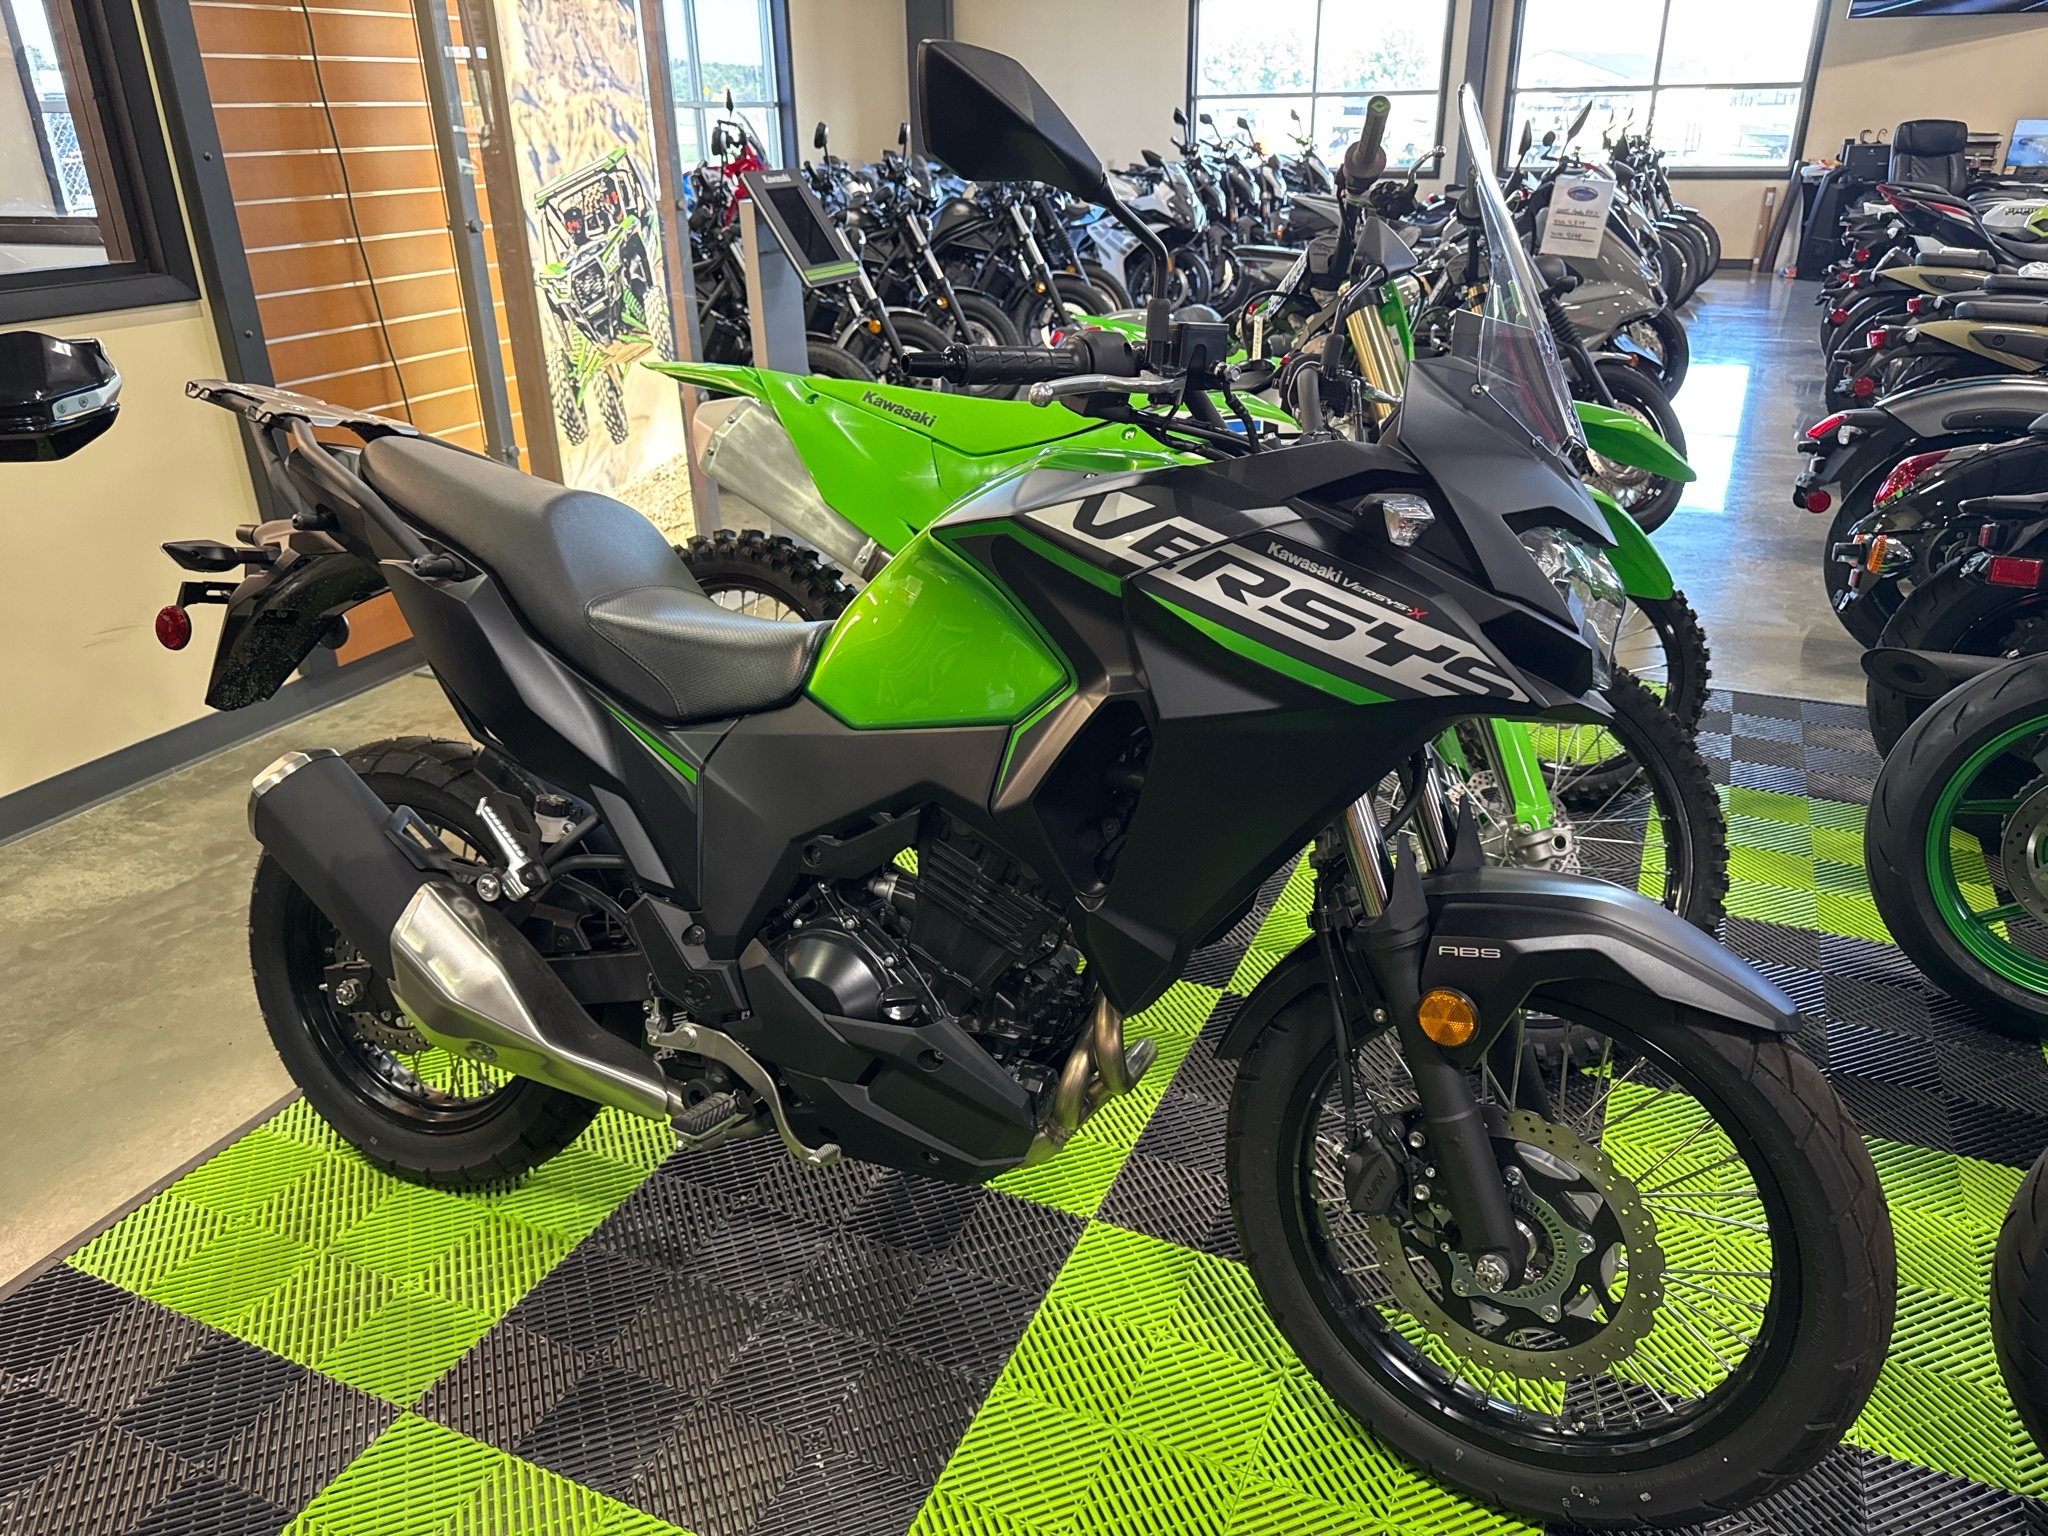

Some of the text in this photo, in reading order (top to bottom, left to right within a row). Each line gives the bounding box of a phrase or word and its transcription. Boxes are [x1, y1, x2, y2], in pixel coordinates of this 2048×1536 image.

[862, 390, 938, 428] Kawasaki
[1073, 492, 1515, 698] VERSYS
[1267, 541, 1429, 620] Kawasaki VERSYS-X
[1438, 945, 1501, 959] ABS
